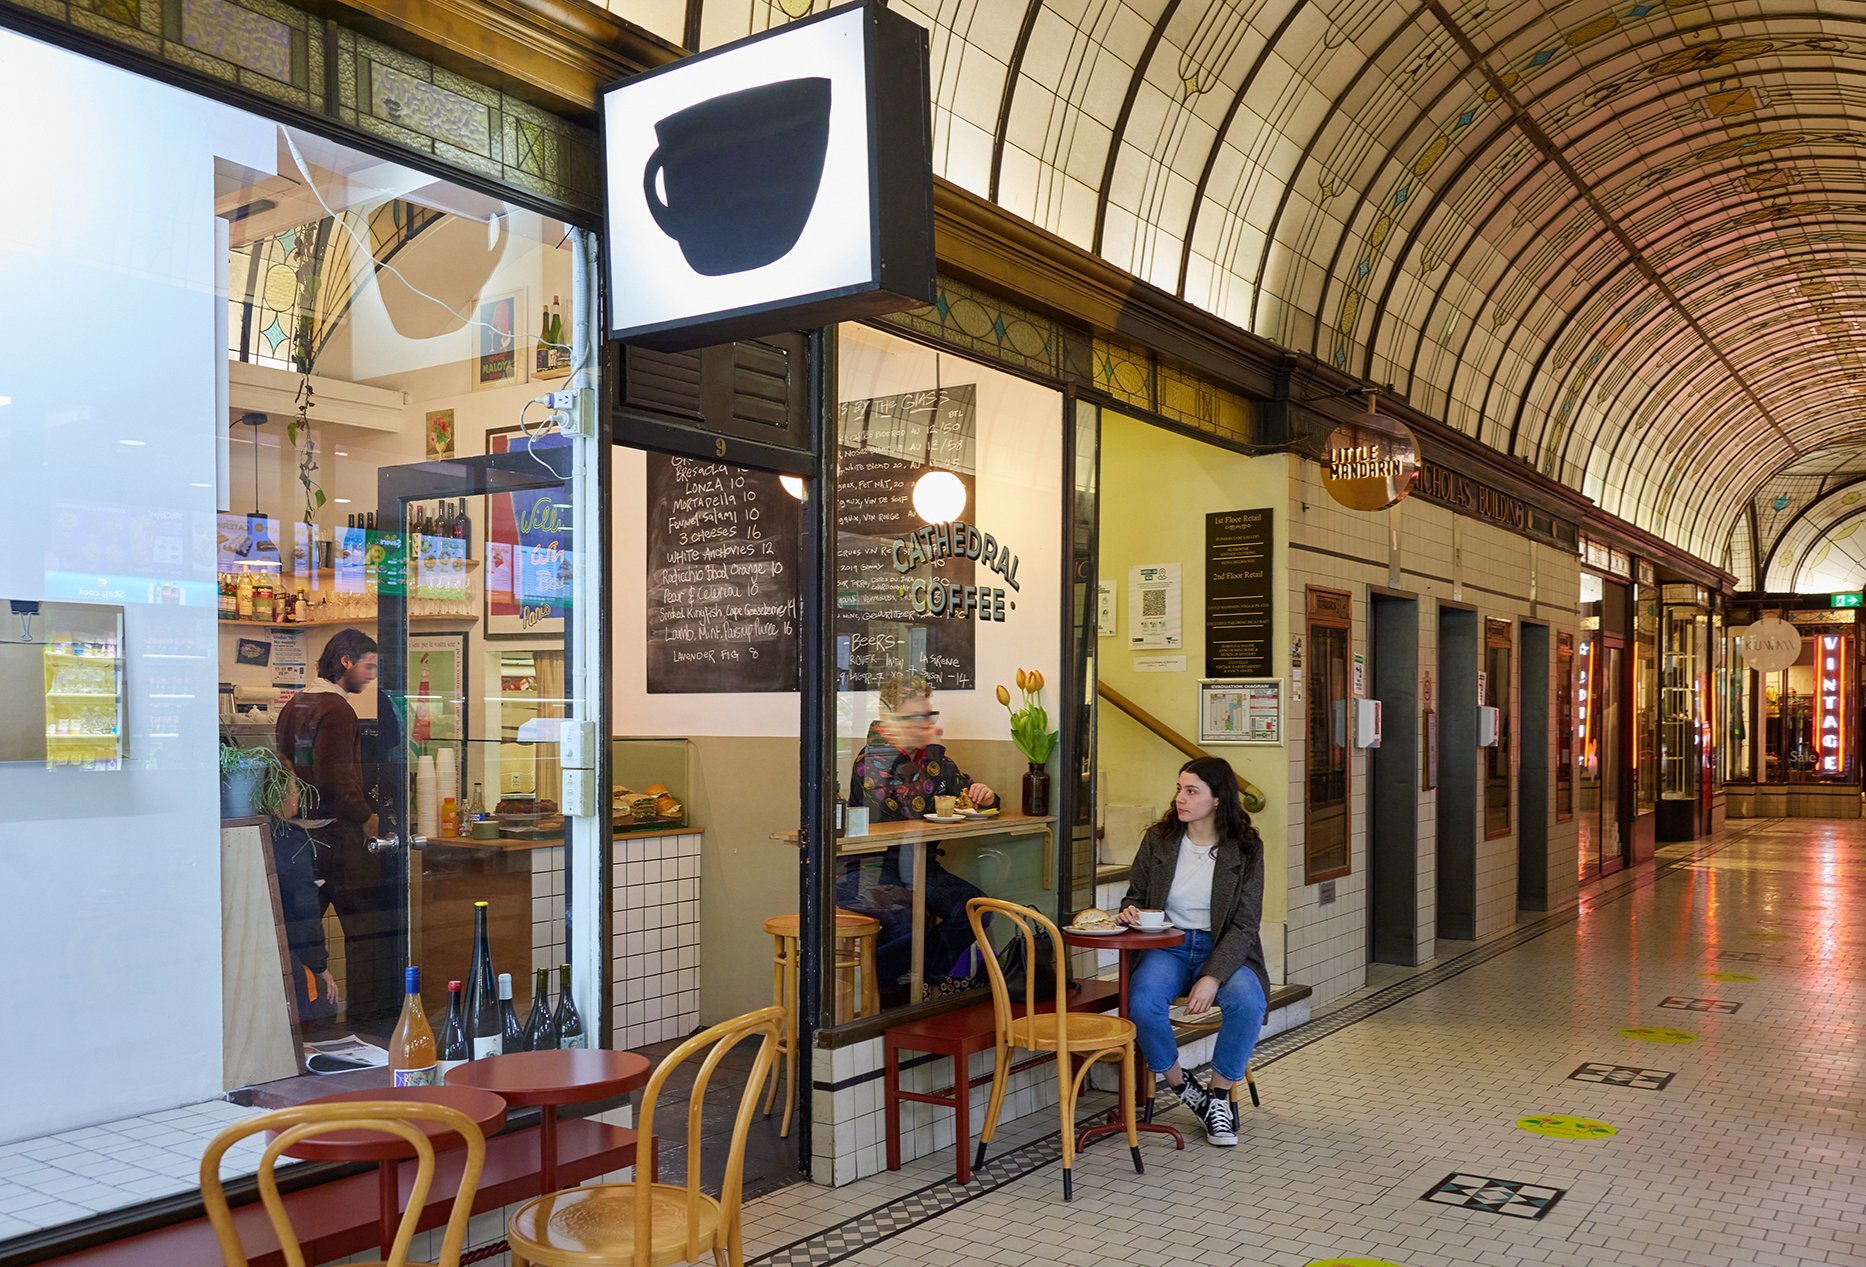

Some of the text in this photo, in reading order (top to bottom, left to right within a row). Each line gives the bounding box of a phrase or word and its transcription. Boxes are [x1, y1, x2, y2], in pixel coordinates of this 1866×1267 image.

[715, 438, 727, 457] 9
[1330, 445, 1379, 464] LITTLE
[1330, 460, 1403, 480] MANDARIN
[685, 477, 745, 495] LONZA 10
[743, 491, 756, 502] 10
[745, 507, 759, 520] 10
[1478, 485, 1525, 531] BUILDING
[1243, 514, 1262, 522] Retail
[680, 532, 688, 545] 3
[747, 524, 761, 539] 16
[762, 542, 774, 554] 12
[892, 521, 1020, 592] CATHEDRAL
[730, 563, 766, 583] Orange
[771, 560, 783, 577] 10
[1244, 570, 1263, 578] Retail
[663, 588, 685, 604] Pear
[911, 578, 1006, 622] COFFEE
[726, 605, 743, 621] Cape
[720, 649, 740, 661] FIG
[749, 648, 759, 660] 8
[1822, 637, 1839, 770] VINTAGE
[1790, 751, 1817, 763] Sale
